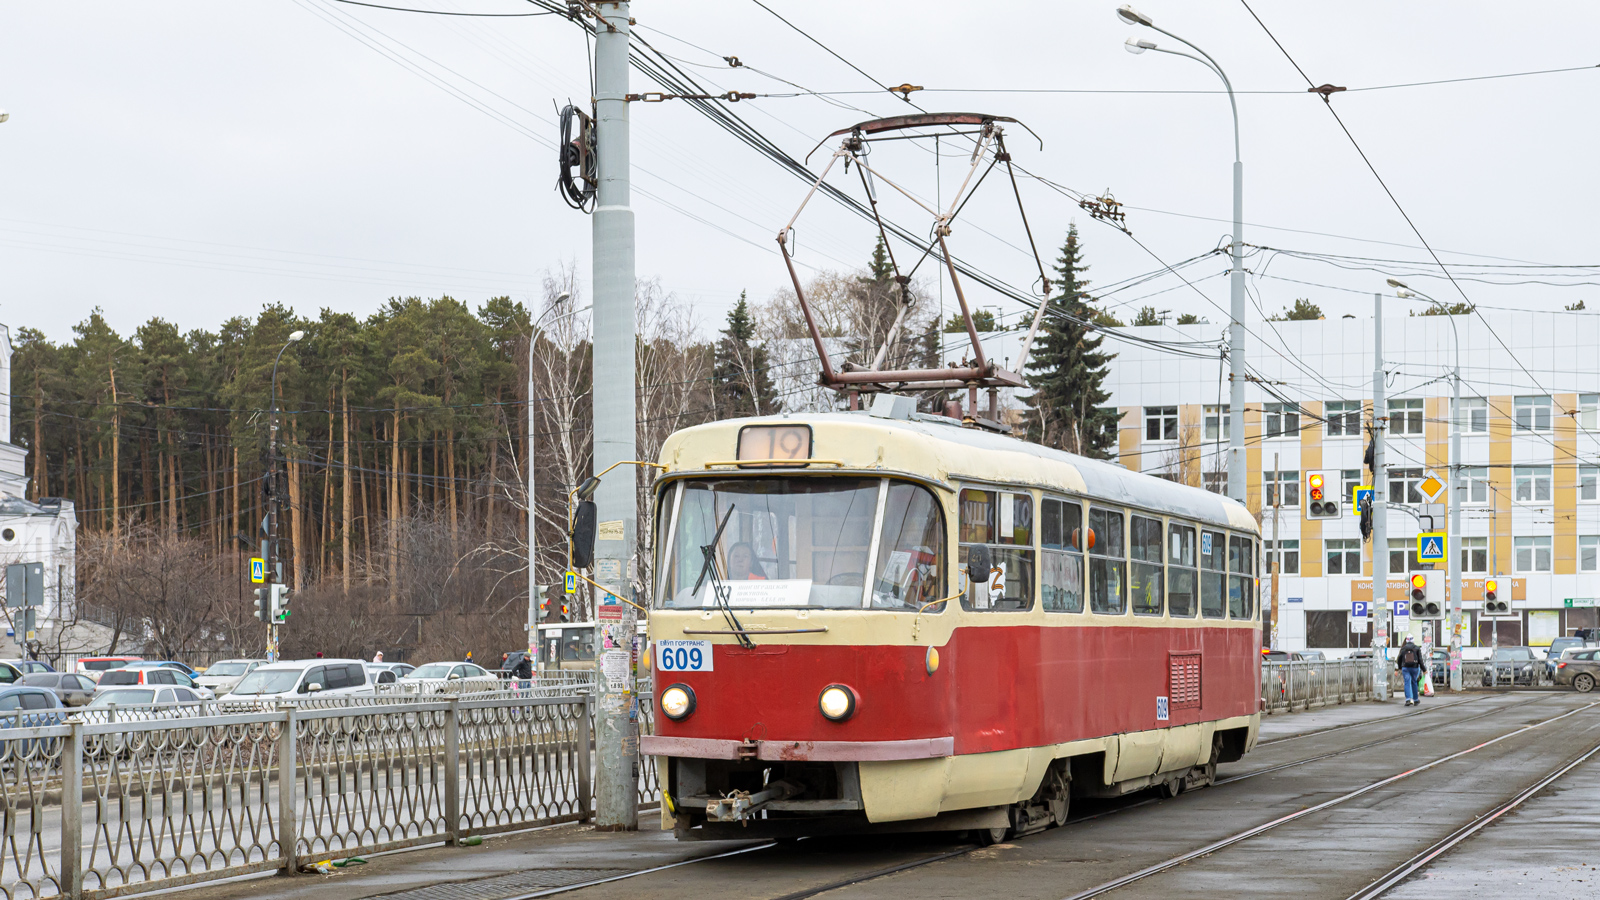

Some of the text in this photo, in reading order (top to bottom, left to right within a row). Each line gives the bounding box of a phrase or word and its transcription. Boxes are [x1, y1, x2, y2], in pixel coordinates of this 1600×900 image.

[767, 429, 803, 466] 19
[1202, 532, 1212, 555] 609
[1355, 603, 1364, 615] P
[1397, 602, 1406, 615] P
[662, 647, 703, 670] 609
[1157, 699, 1168, 719] 609
